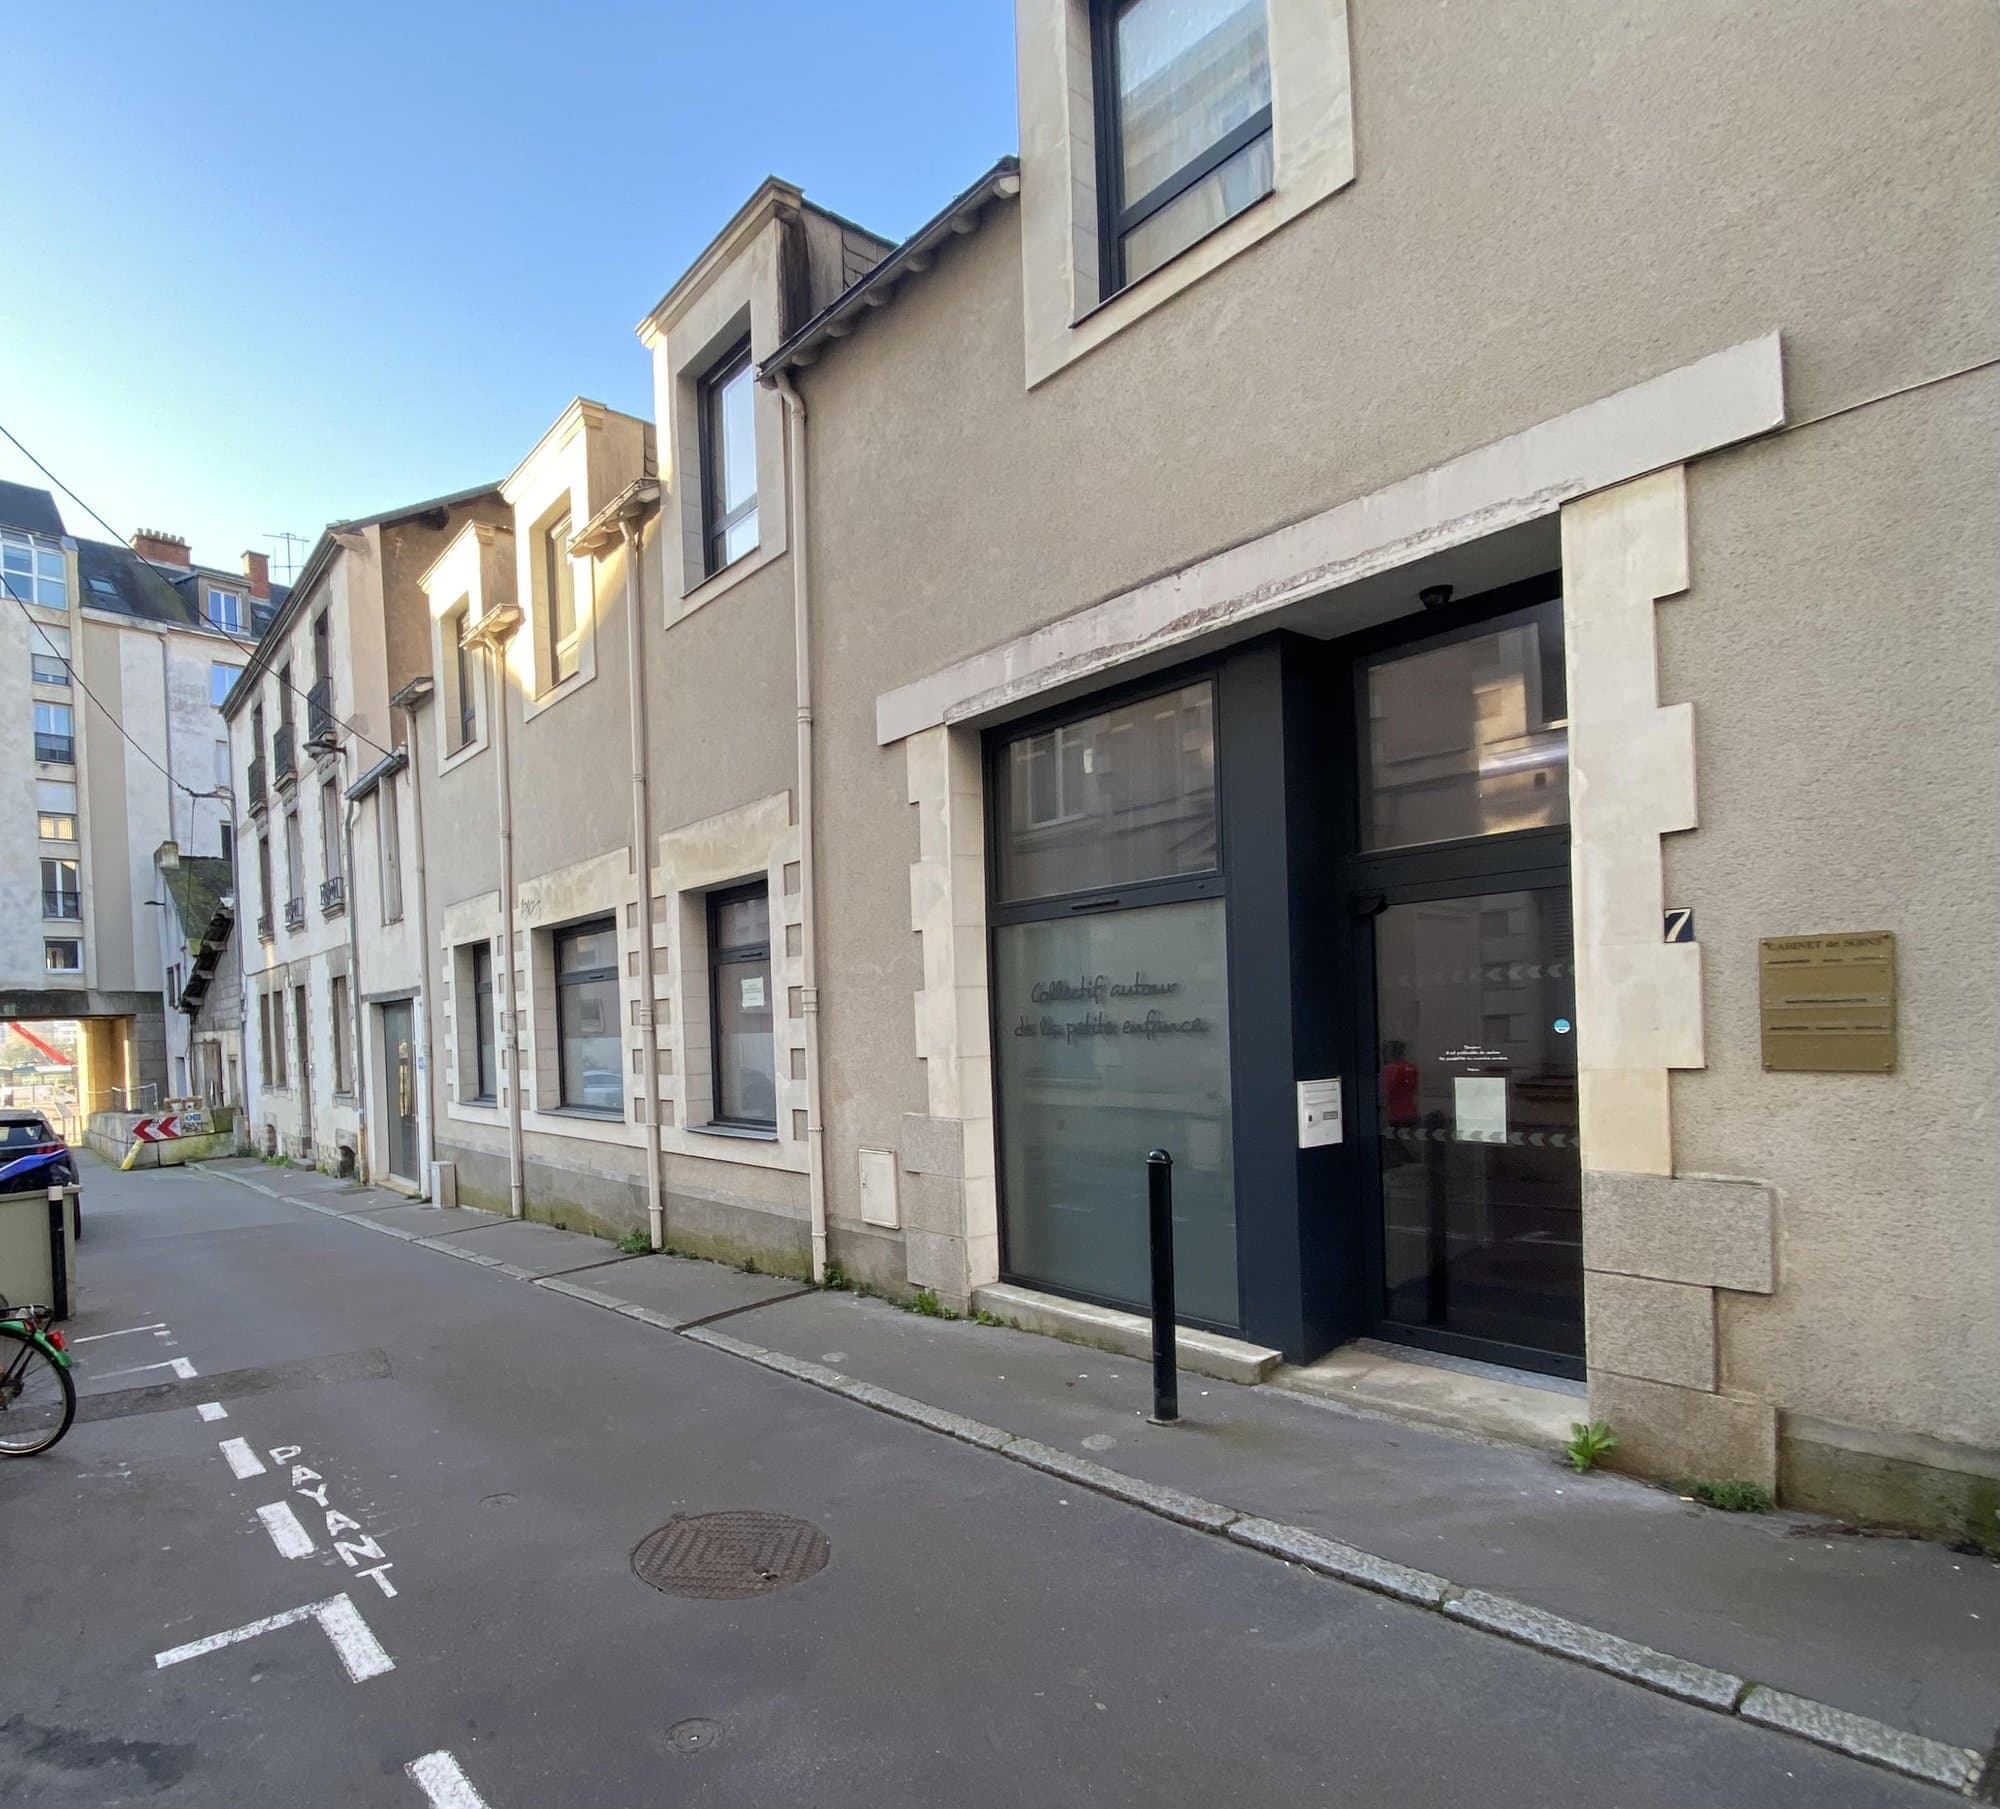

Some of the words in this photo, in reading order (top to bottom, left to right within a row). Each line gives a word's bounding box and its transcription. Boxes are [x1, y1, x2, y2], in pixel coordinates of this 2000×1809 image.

[1665, 908, 1691, 942] 7
[1031, 975, 1104, 1004] Collectif
[1110, 971, 1181, 998] autour
[1015, 1015, 1035, 1037] de
[1067, 1011, 1119, 1044] petite
[1122, 1009, 1209, 1040] enfance
[268, 1445, 398, 1599] PAYANT
